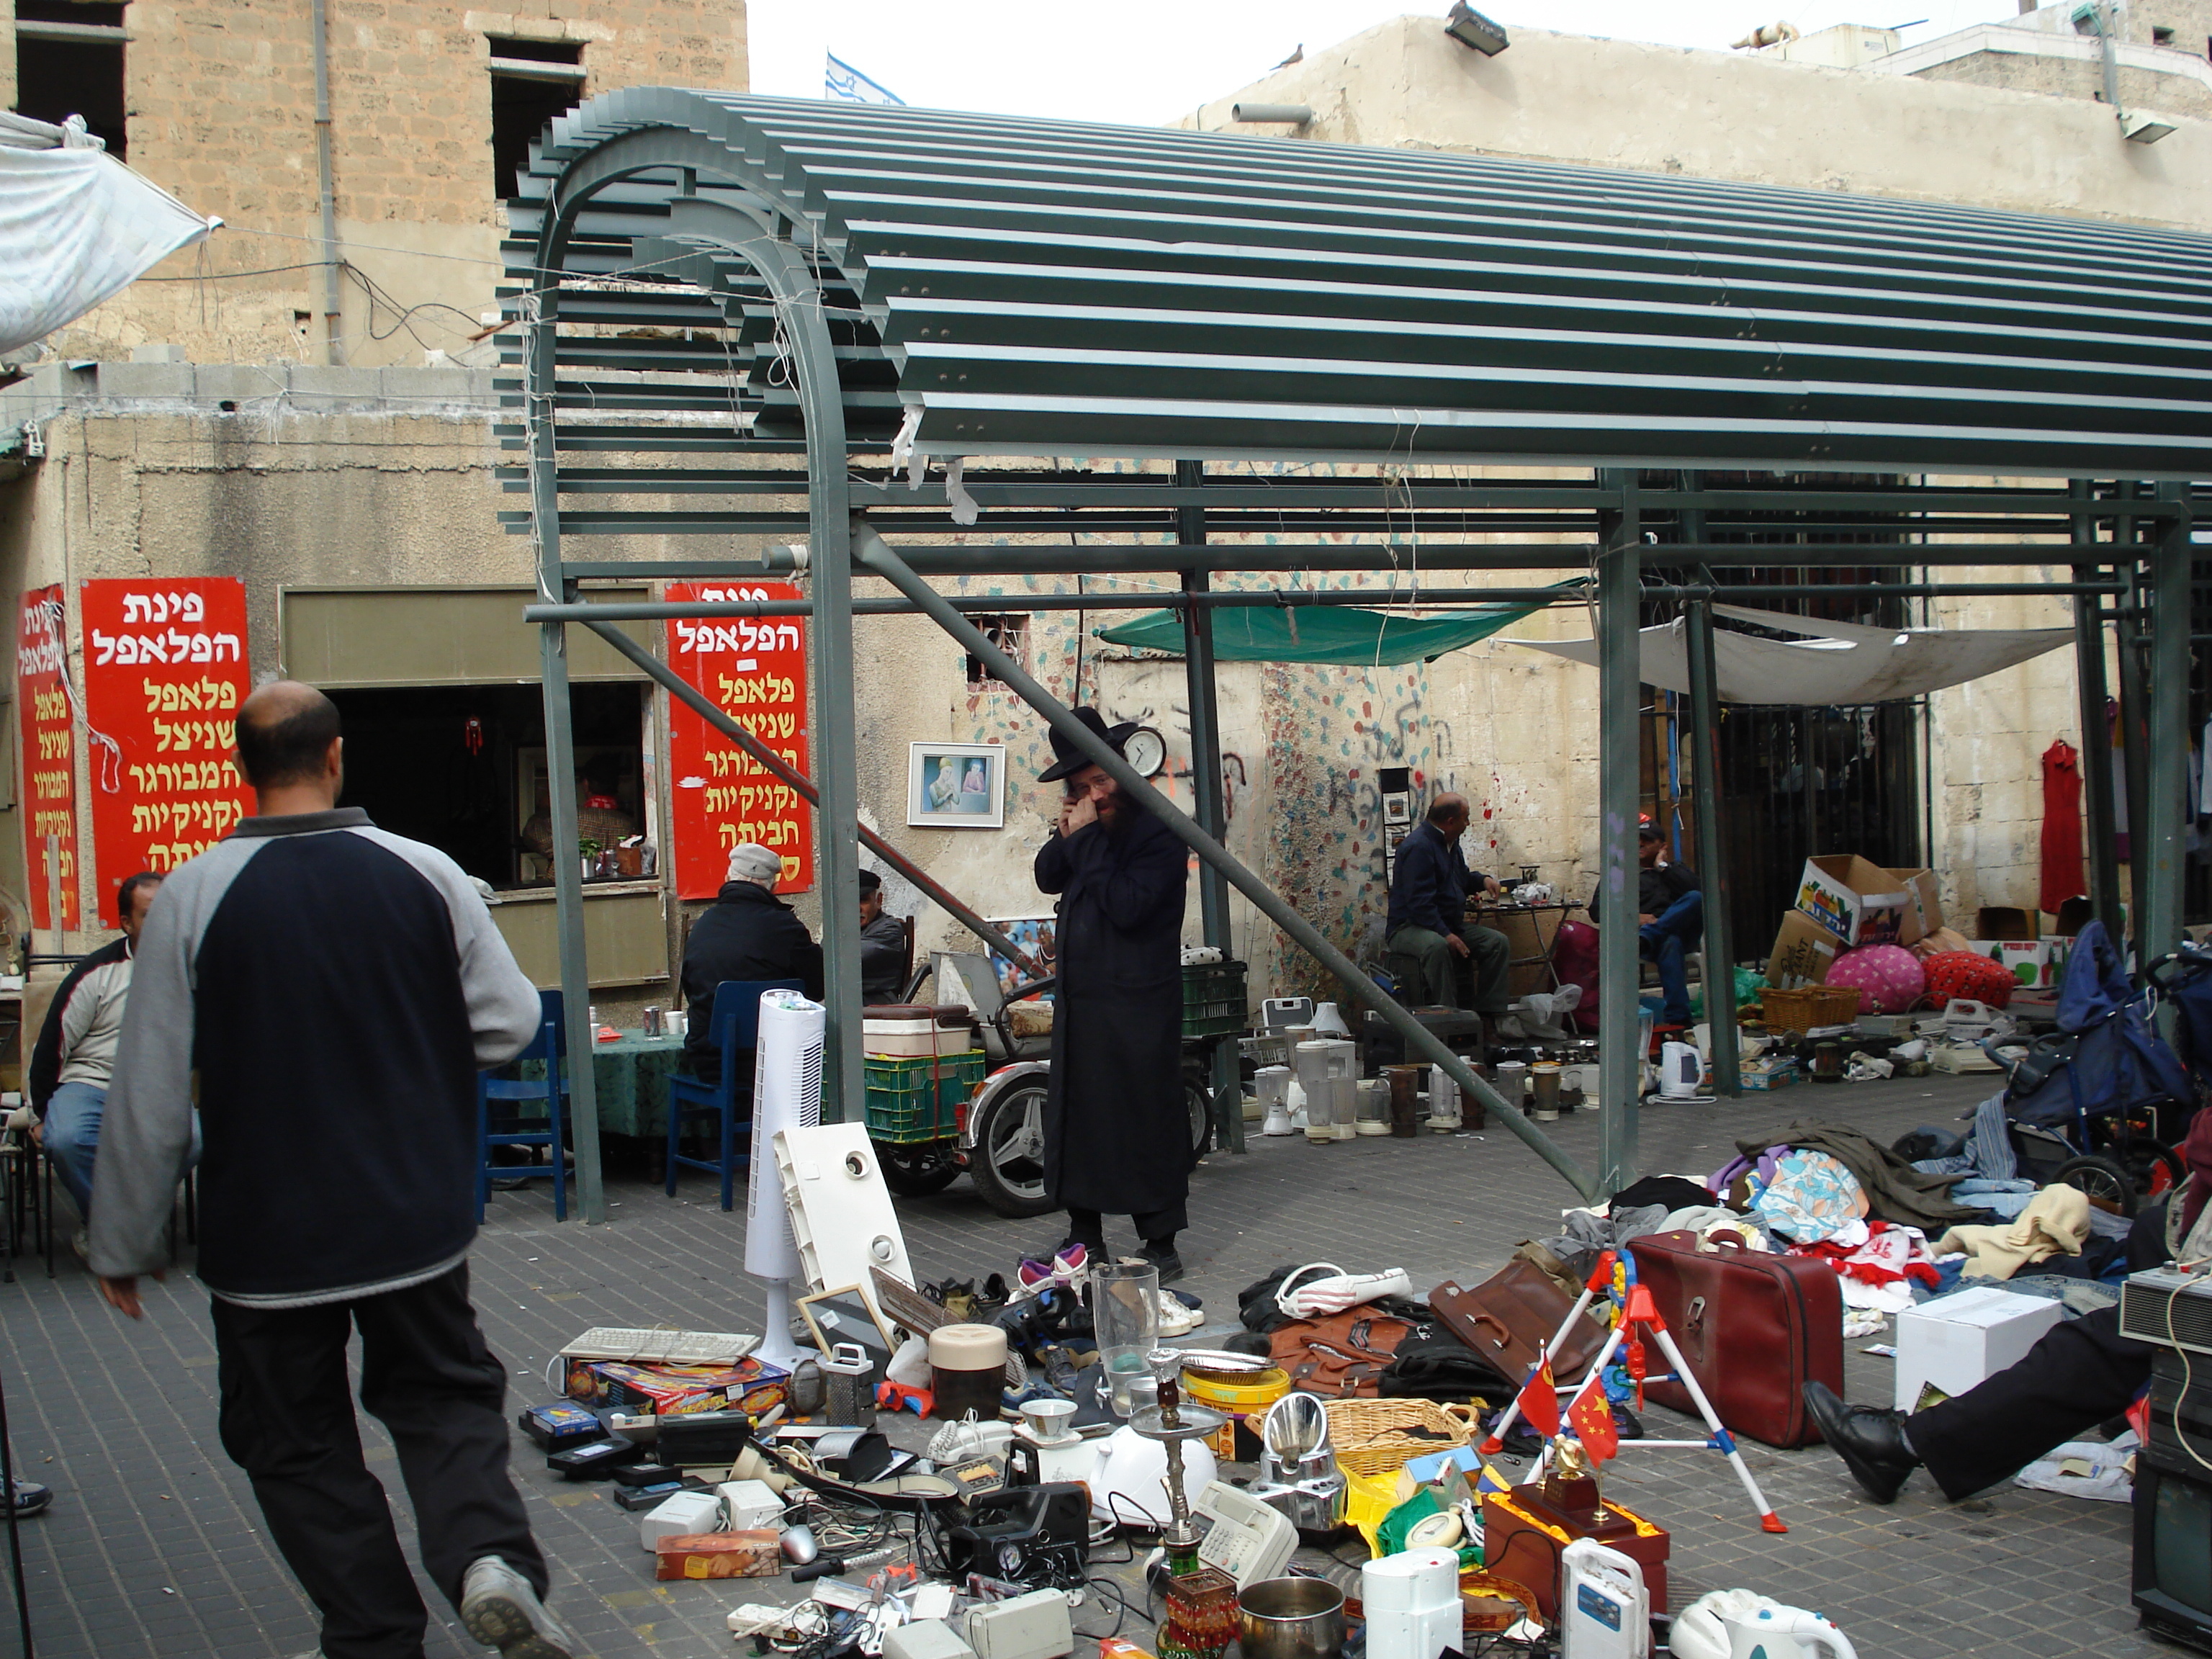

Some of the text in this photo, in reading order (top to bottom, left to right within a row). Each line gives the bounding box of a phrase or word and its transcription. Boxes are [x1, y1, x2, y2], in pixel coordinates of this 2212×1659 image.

[122, 591, 204, 624] פינת
[92, 627, 239, 665] הפלאפל
[676, 619, 799, 653] הפלאפל
[34, 683, 66, 721] פלאפל
[143, 675, 235, 713] פלאפל
[718, 672, 794, 704] פלאפל
[38, 727, 69, 760] שניצל
[153, 716, 236, 752] שניצל
[34, 770, 68, 800] המבורגר
[129, 760, 241, 793] המבורגר
[706, 784, 798, 819] נקניקיות
[132, 799, 243, 839] נקניקיות
